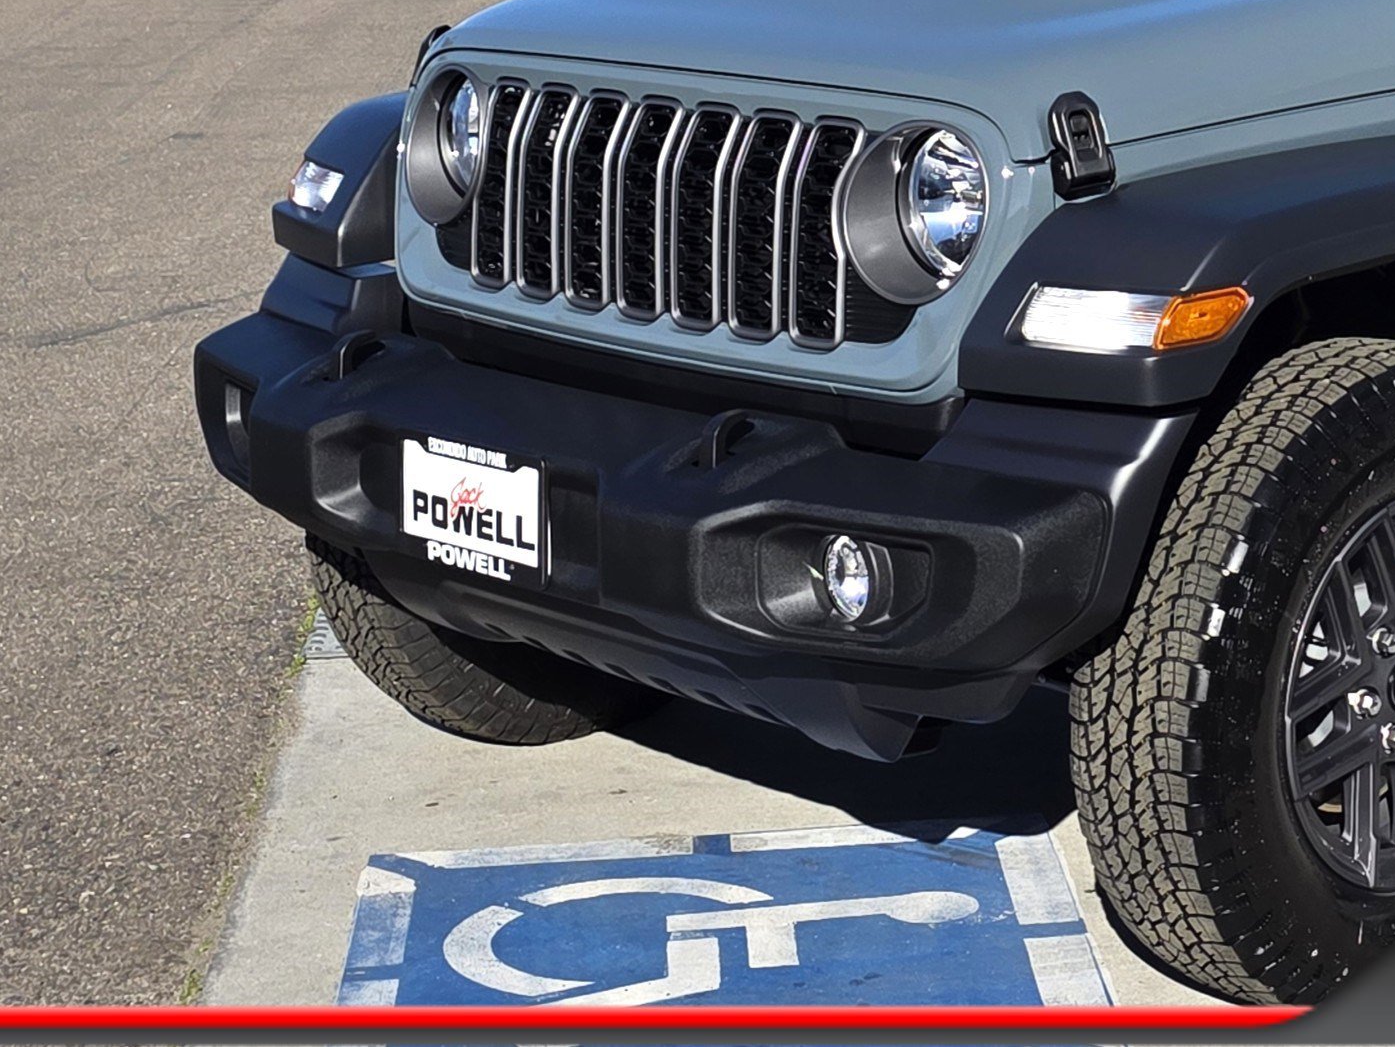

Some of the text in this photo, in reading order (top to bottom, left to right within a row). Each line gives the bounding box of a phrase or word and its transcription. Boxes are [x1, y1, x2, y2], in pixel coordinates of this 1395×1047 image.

[450, 476, 487, 518] Jack
[412, 488, 536, 552] POWELL
[426, 539, 512, 582] POWELL
